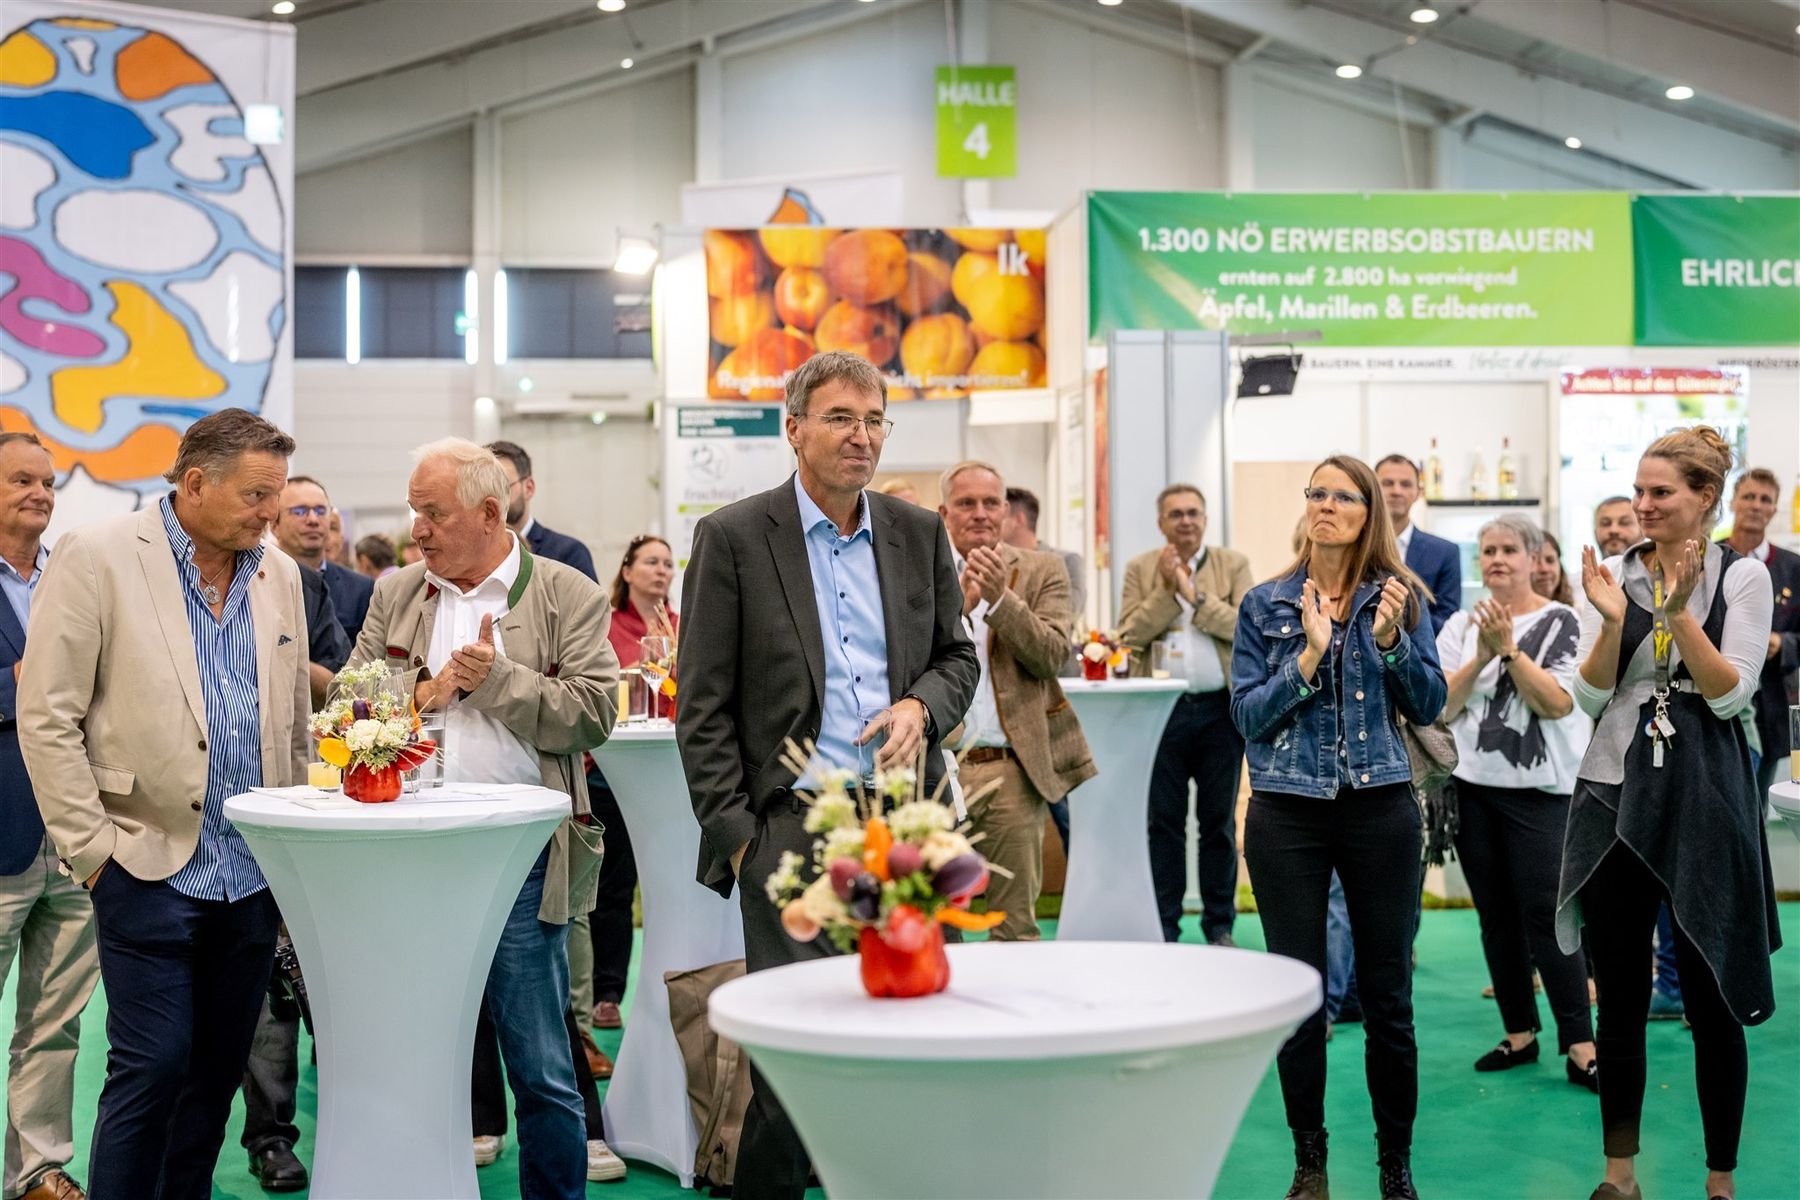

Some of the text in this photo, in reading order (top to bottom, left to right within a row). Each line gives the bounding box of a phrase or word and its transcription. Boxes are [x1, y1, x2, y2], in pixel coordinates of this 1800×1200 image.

[938, 82, 1016, 107] HALLE
[963, 122, 992, 160] 4
[1138, 222, 1595, 253] 1.300 NÖ ERWERBSOBSTBAUERN
[1218, 267, 1518, 293] ernten auf 2.800 ha vorwiegend
[1198, 288, 1538, 327] Äpfel, Marillen & Erdbeeren.
